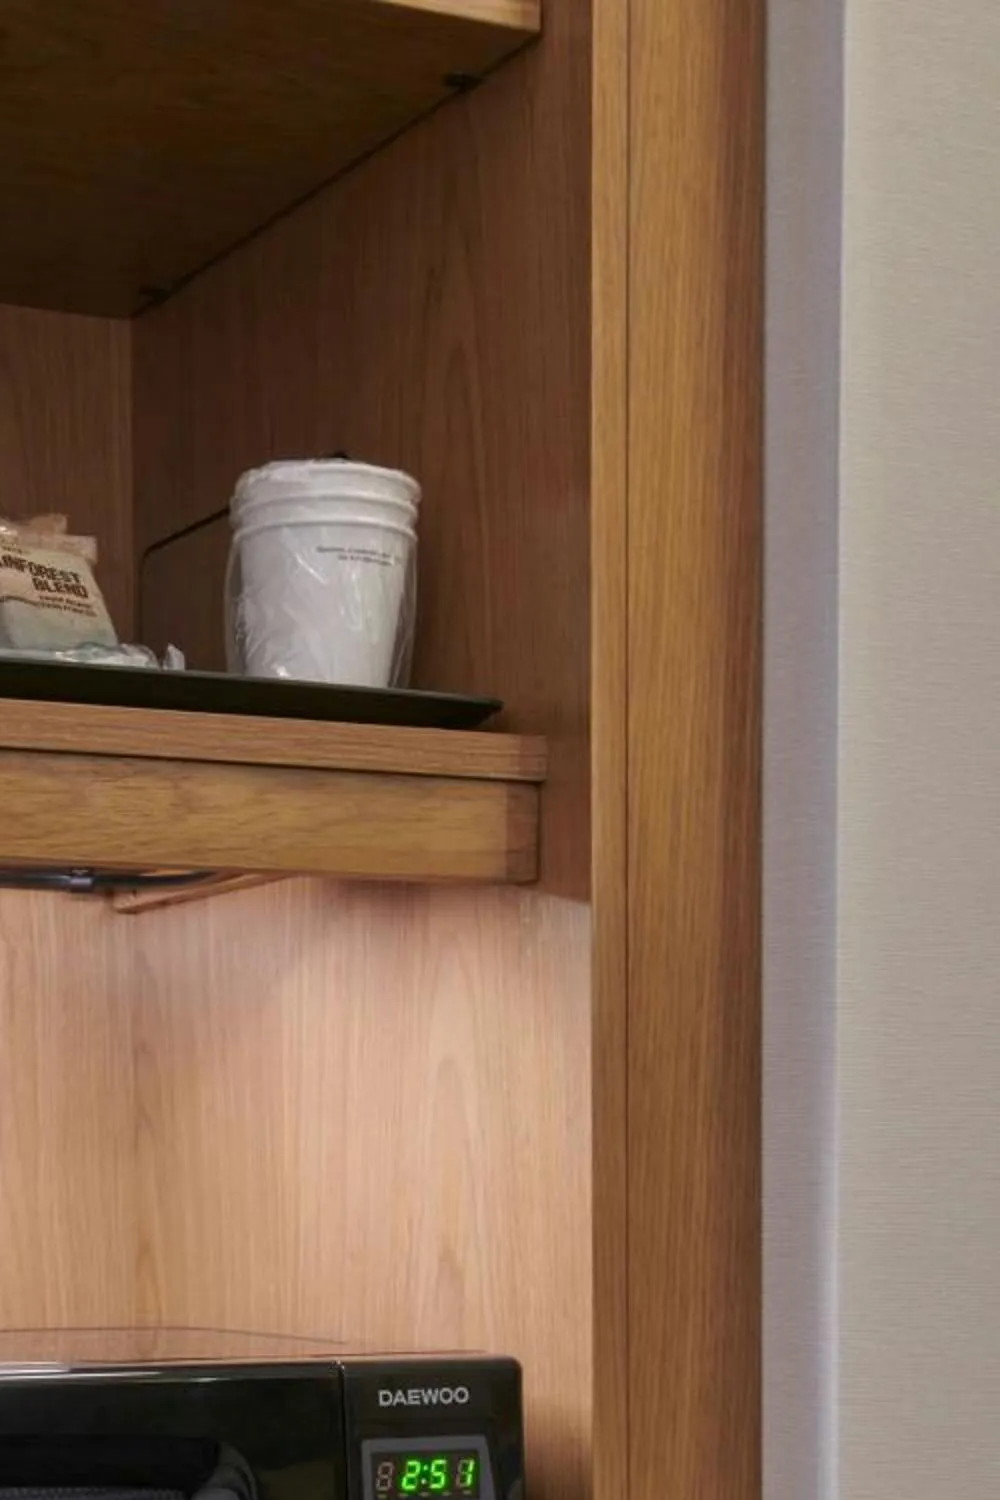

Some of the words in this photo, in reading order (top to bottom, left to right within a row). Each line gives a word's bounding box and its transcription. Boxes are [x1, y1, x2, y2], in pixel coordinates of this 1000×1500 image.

[31, 577, 89, 599] BLEND
[378, 1387, 470, 1406] DAEWOO
[401, 1460, 476, 1490] 2:51
